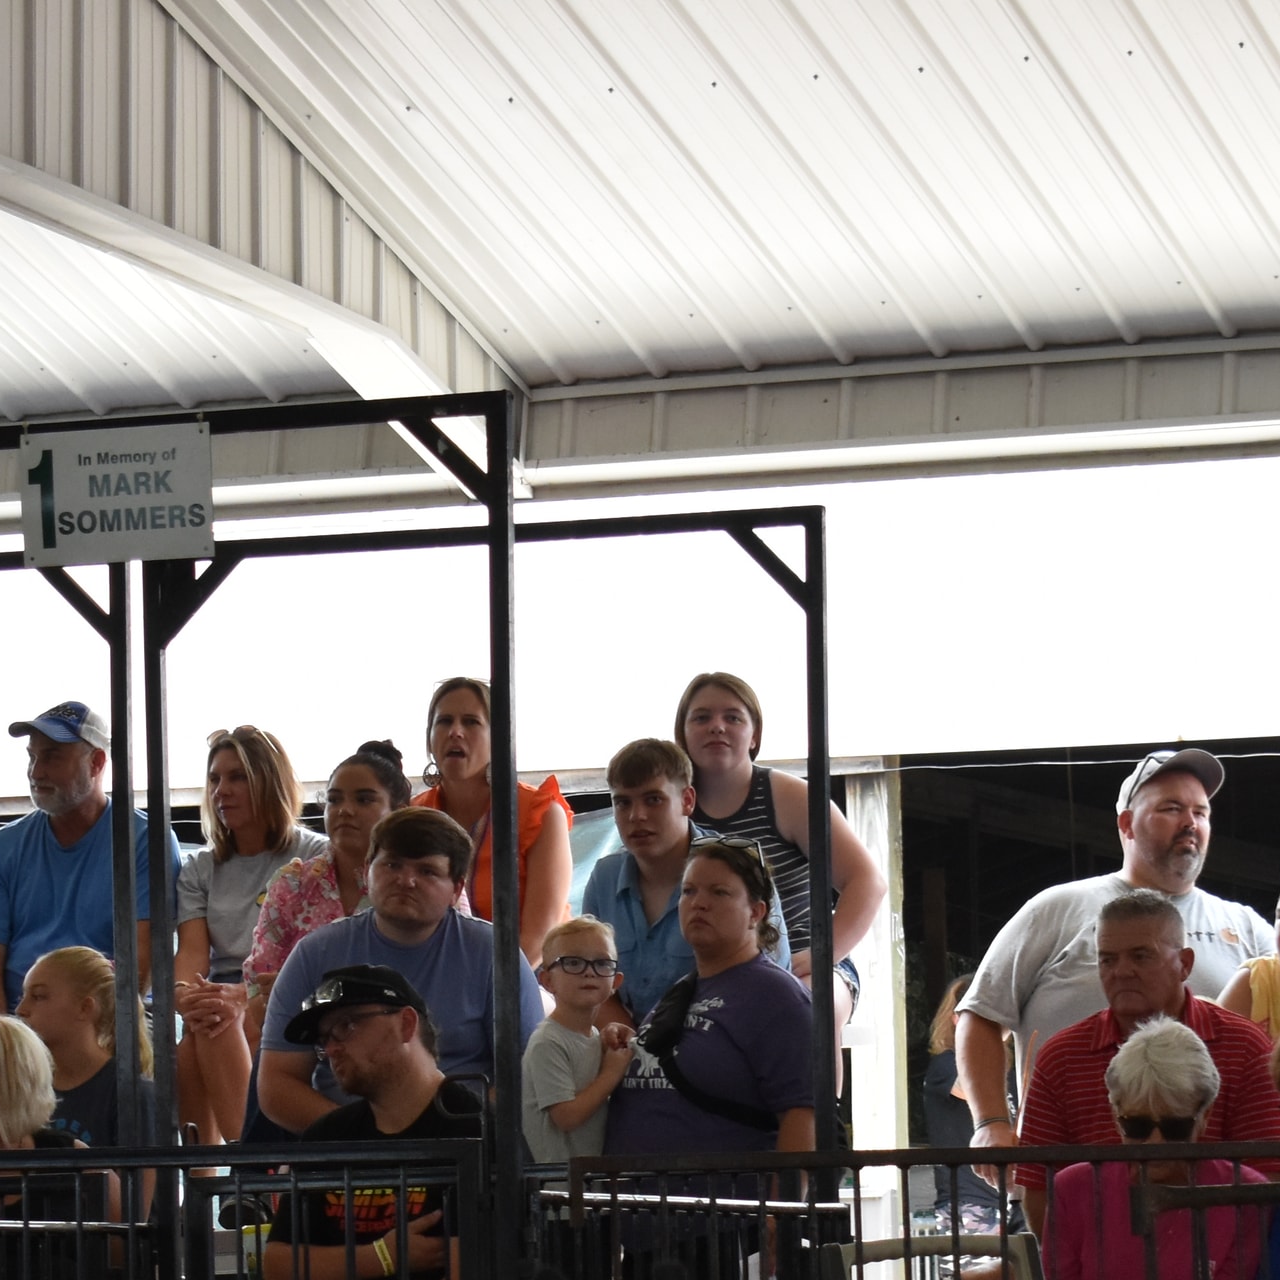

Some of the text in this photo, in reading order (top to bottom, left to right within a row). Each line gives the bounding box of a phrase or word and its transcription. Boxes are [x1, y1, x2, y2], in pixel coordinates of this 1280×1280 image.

[78, 448, 177, 467] In Memory of
[88, 470, 174, 498] MARK
[28, 450, 57, 549] 1
[58, 503, 207, 536] SOMMERS
